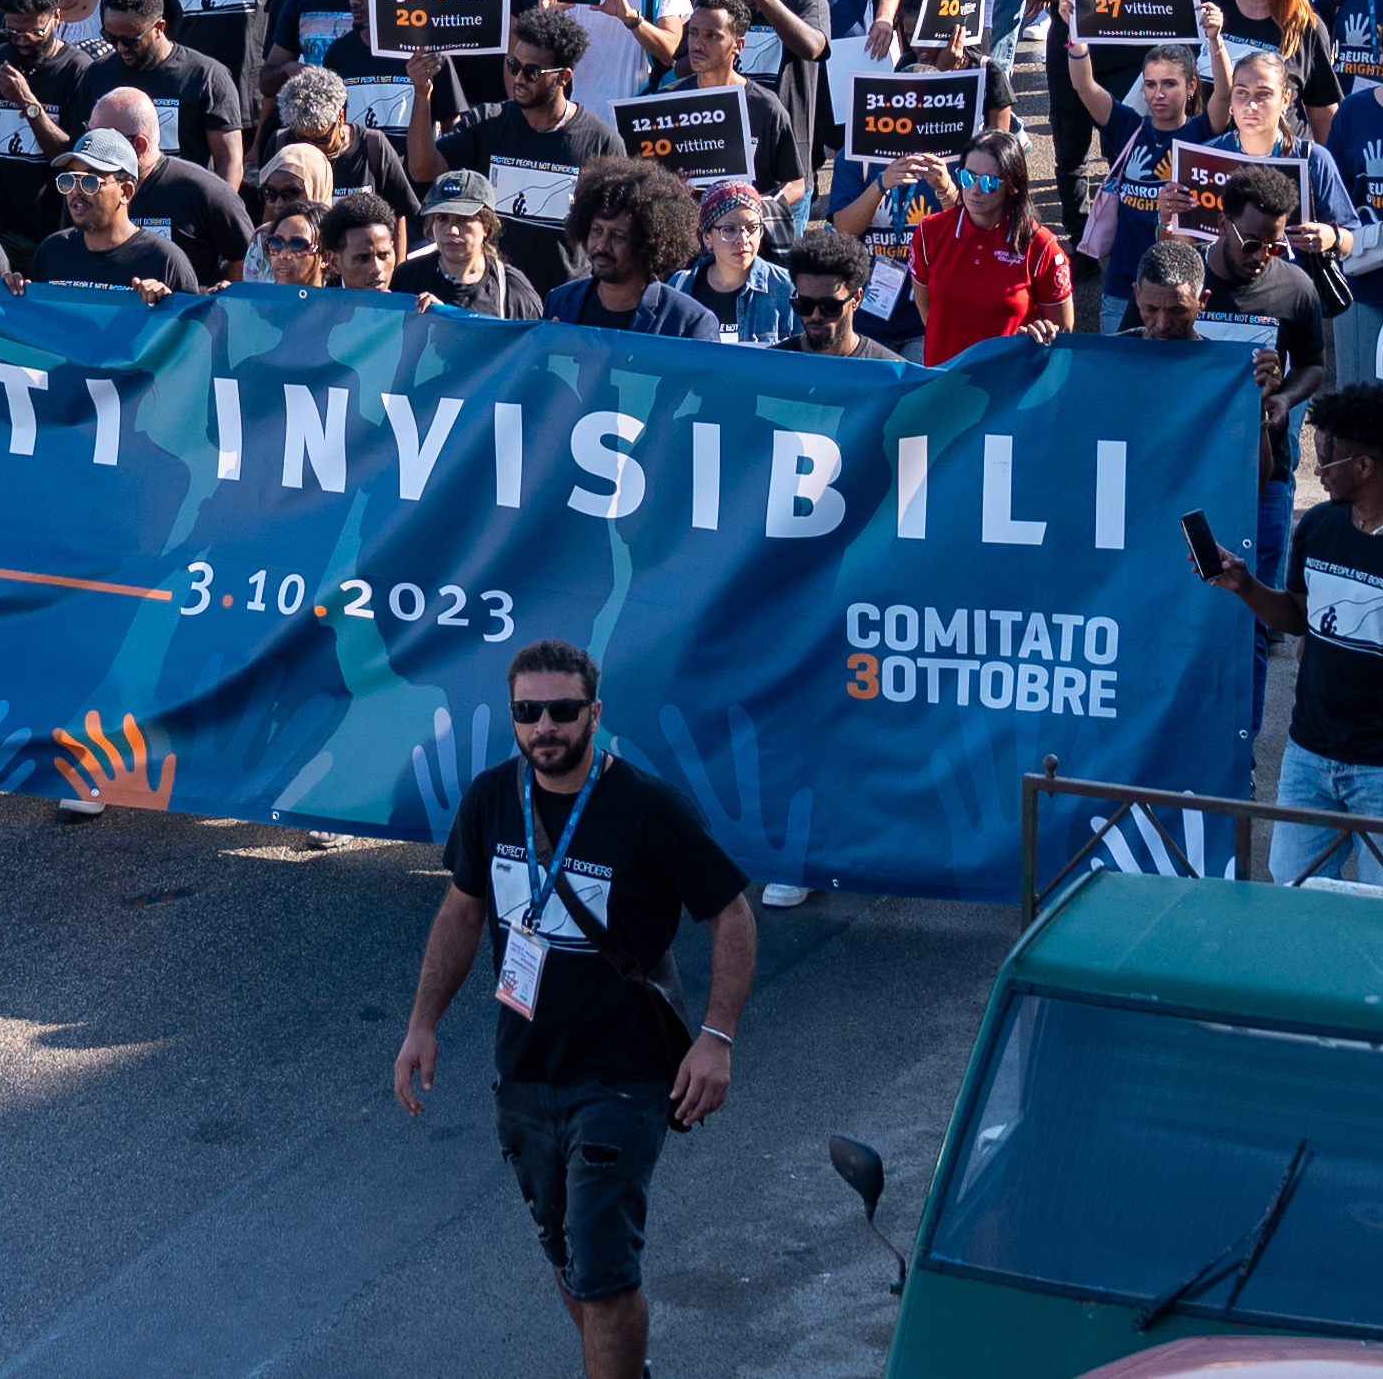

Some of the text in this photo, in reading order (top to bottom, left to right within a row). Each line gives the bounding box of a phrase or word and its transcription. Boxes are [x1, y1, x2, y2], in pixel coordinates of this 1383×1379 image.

[396, 9, 483, 28] 20 vittime
[939, 0, 960, 17] 20
[1124, 2, 1174, 16] vittime
[866, 91, 966, 110] 31.08.2014
[633, 109, 726, 133] 12.11.2020
[865, 115, 964, 136] 100 vittime
[640, 136, 726, 157] 20 vittime
[1207, 311, 1233, 322] PEOPLE
[1235, 313, 1249, 323] NOT
[214, 377, 1127, 551] INVISIBILI
[180, 560, 517, 644] 3.10.2023
[847, 602, 1119, 668] COMITATO
[846, 652, 1118, 719] 3OTTOBRE
[573, 859, 613, 879] BORDERS
